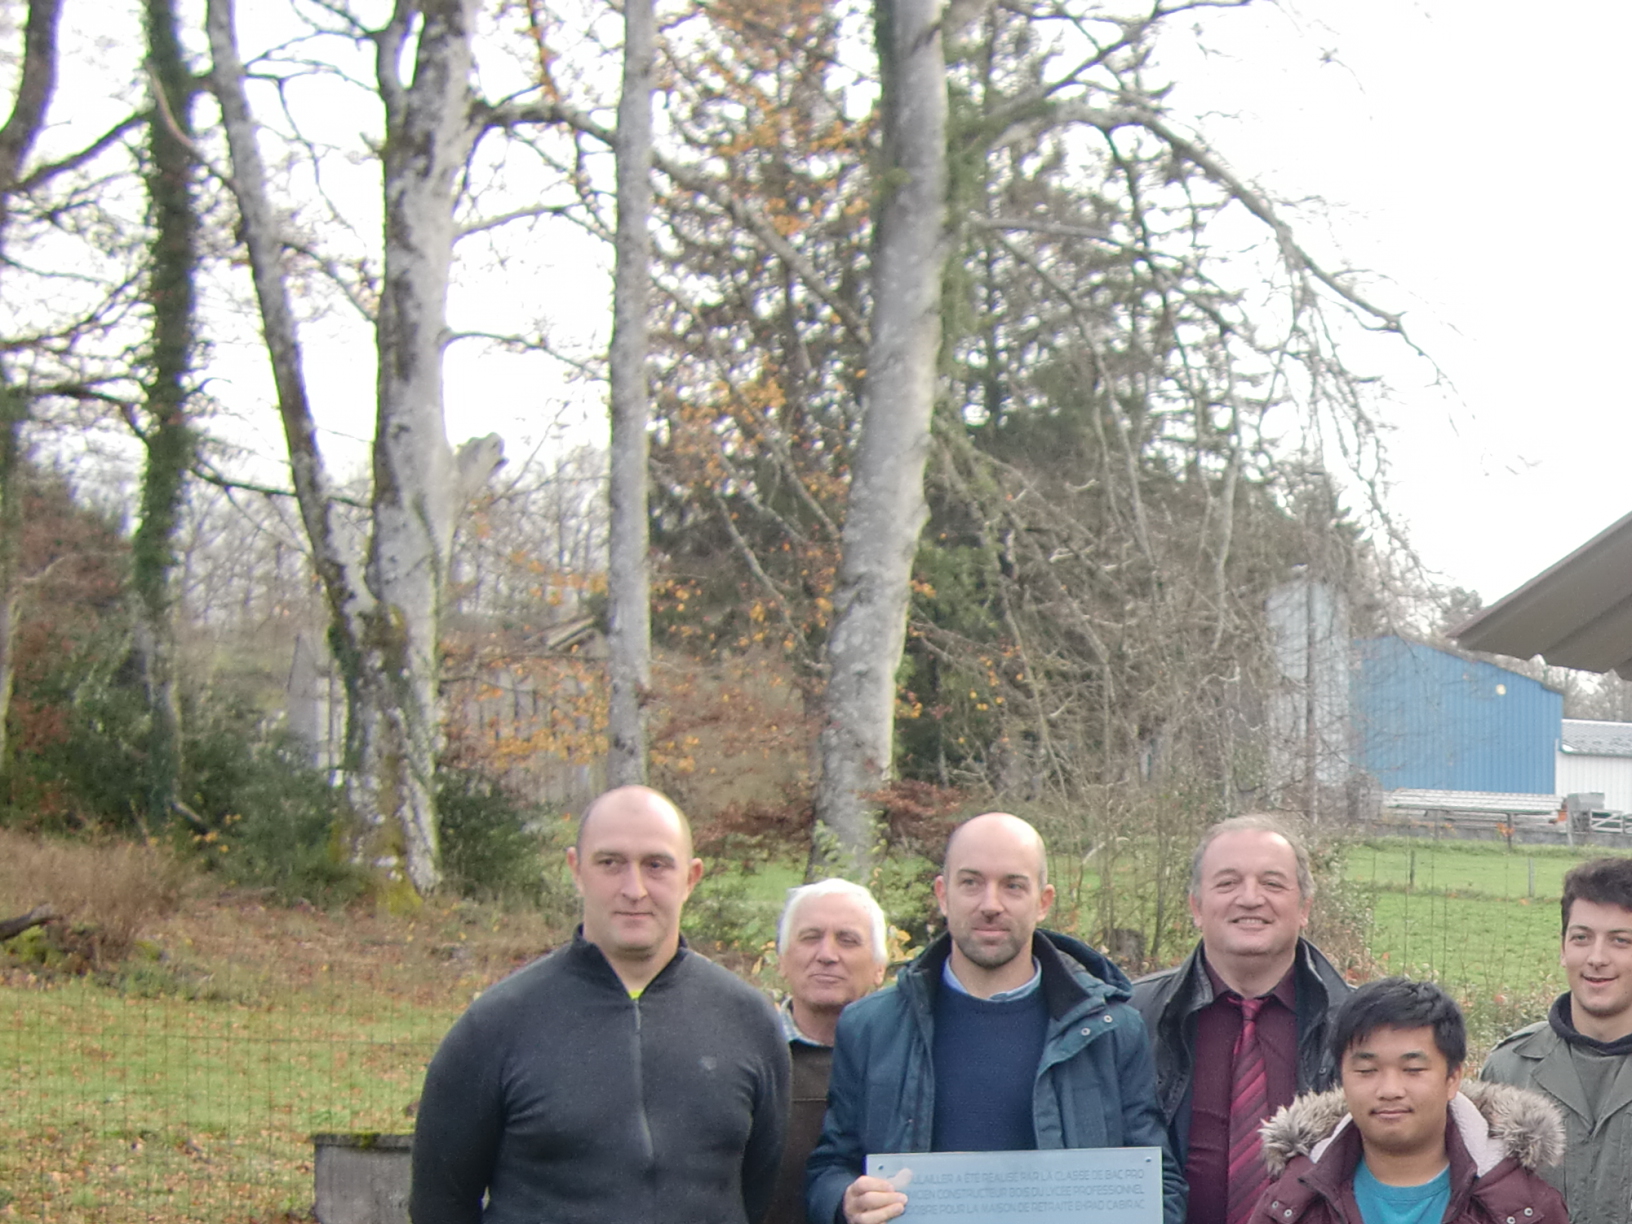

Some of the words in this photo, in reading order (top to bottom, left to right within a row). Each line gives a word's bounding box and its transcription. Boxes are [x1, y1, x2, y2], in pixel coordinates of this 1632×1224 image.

[1020, 1170, 1039, 1182] PAR
[1041, 1170, 1053, 1182] LA
[1055, 1169, 1090, 1182] CLASSE
[1092, 1169, 1104, 1181] DE
[1105, 1168, 1124, 1181] BAC
[1125, 1168, 1145, 1180] PRO
[937, 1187, 1007, 1200] CONSTRUCTEUR
[1009, 1186, 1030, 1199] BOIS
[1031, 1185, 1045, 1198] DU
[1073, 1183, 1145, 1197] PROFESSIONNEL
[939, 1203, 965, 1215] POUR
[966, 1202, 979, 1214] LA
[981, 1202, 1017, 1214] MAISON
[1018, 1201, 1030, 1213] DE
[1031, 1200, 1074, 1213] RETRAITE
